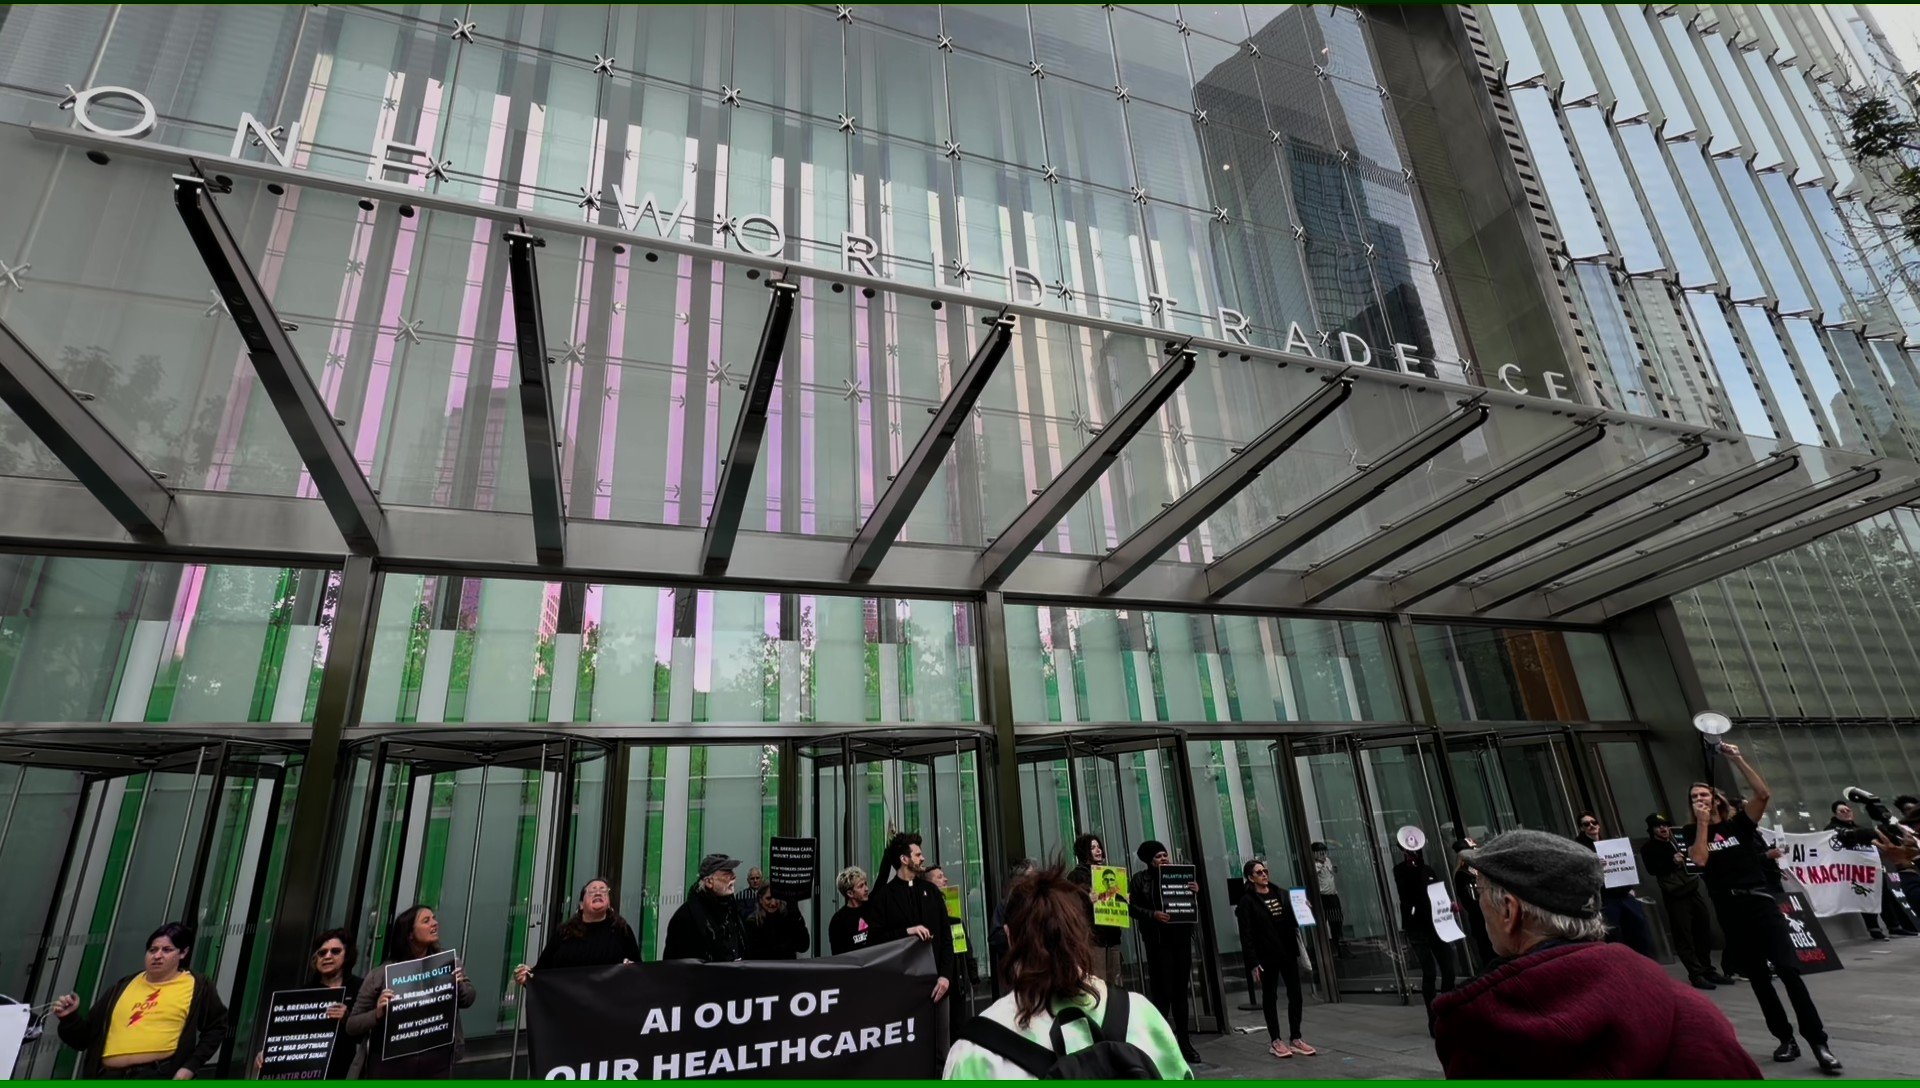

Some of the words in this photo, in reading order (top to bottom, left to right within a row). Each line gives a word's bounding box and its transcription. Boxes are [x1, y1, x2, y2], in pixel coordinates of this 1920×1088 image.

[74, 86, 427, 188] ONE
[612, 183, 1046, 306] WORLD
[1150, 292, 1426, 377] TRADE
[1793, 844, 1805, 862] AI
[1807, 863, 1876, 884] MACHINE
[1789, 895, 1803, 911] AI
[1789, 931, 1817, 948] FUELS
[392, 971, 431, 985] PALANTIR
[432, 965, 451, 977] OUT!
[403, 987, 434, 999] BRENDAN
[435, 982, 454, 993] CARR,
[131, 1001, 158, 1011] POP
[274, 1005, 285, 1013] DR.
[287, 1002, 318, 1011] BRENDAN
[392, 1001, 417, 1012] MOUNT
[419, 997, 436, 1006] SINAI
[641, 1006, 681, 1035] AI
[694, 996, 779, 1028] OUT
[789, 988, 840, 1017] OF
[274, 1014, 299, 1023] MOUNT
[300, 1013, 317, 1021] SINAI
[398, 1020, 414, 1030] NEW
[415, 1014, 444, 1026] YORKERS
[282, 1033, 309, 1041] YORKERS
[390, 1030, 419, 1042] DEMAND
[420, 1023, 449, 1036] PRIVACY!
[267, 1045, 278, 1053] ICE
[297, 1041, 329, 1050] SOFTWARE
[653, 1018, 916, 1080] HEALTHCARE!
[277, 1054, 286, 1062] OF
[300, 1069, 321, 1079] OUT!
